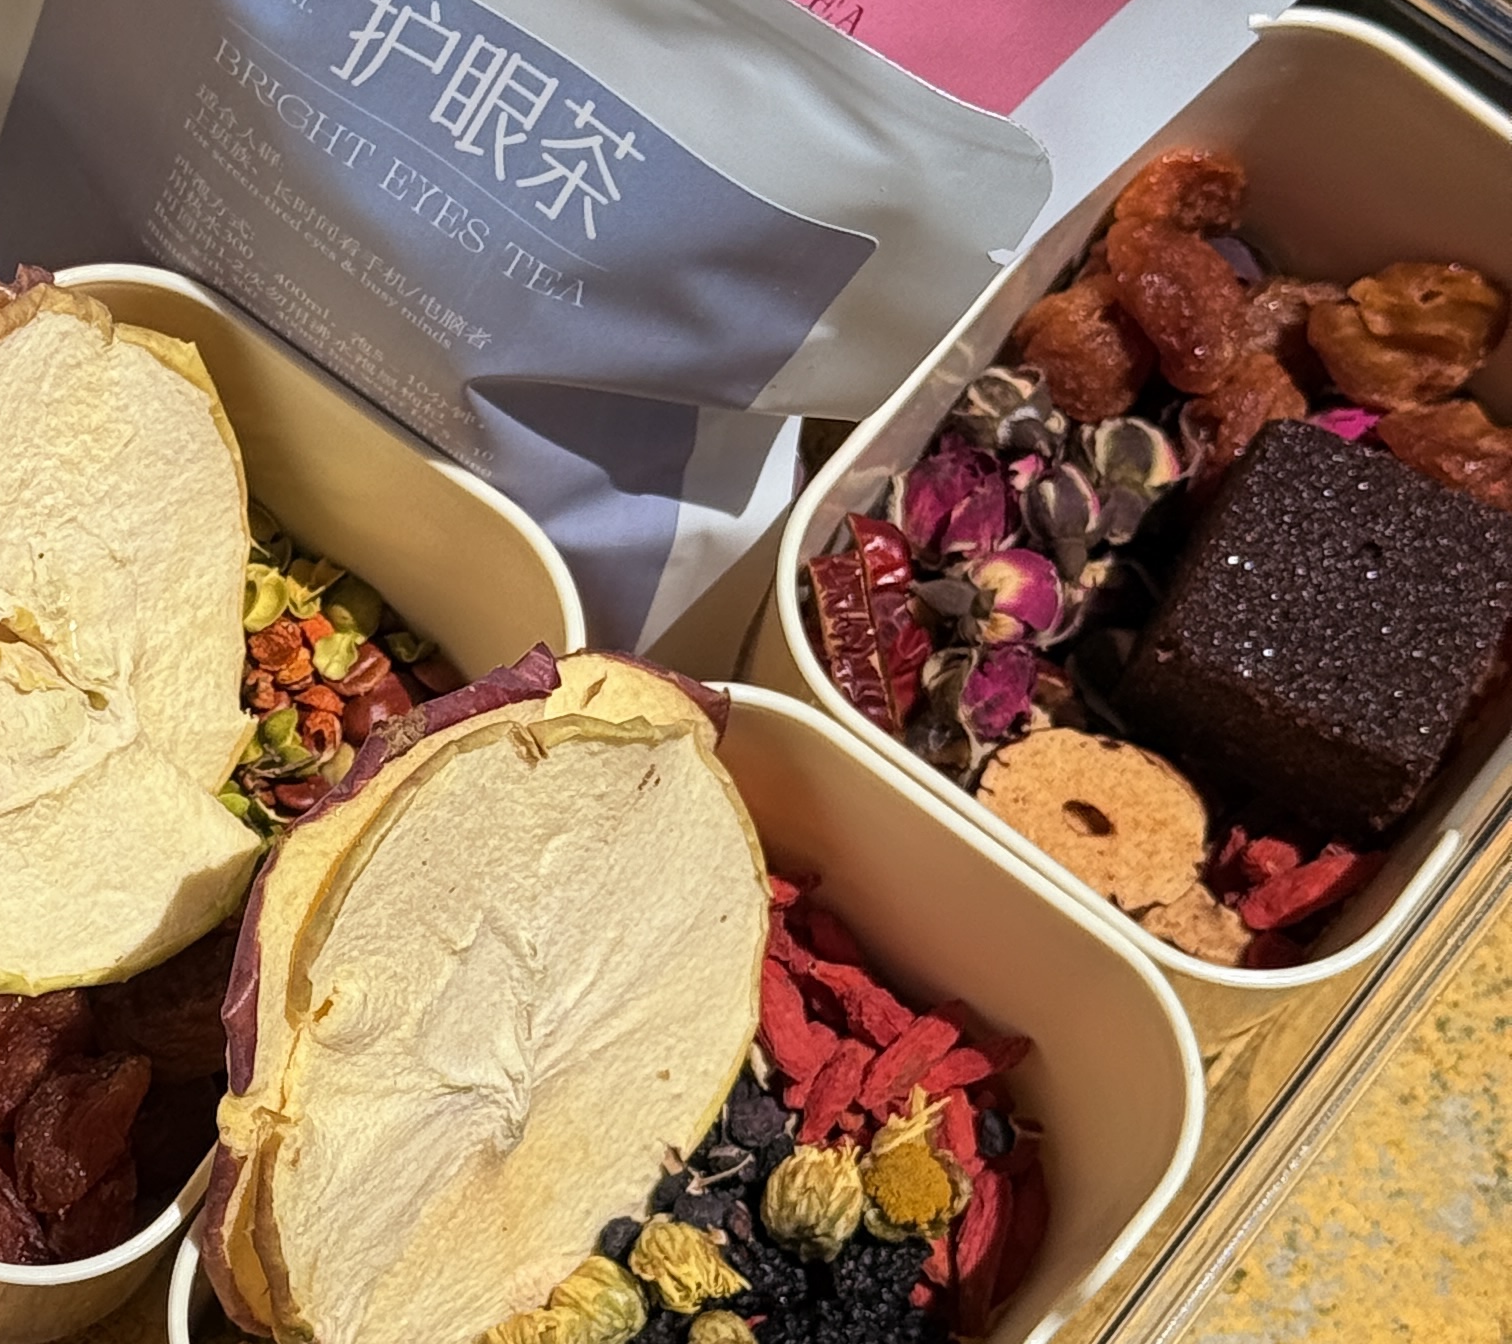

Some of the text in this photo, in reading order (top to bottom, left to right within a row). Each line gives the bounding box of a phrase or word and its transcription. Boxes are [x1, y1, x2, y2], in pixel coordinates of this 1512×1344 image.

[213, 36, 586, 309] BRIGHT EYES TEA
[303, 230, 336, 262] eyes
[360, 272, 399, 308] busy
[400, 307, 453, 351] minds
